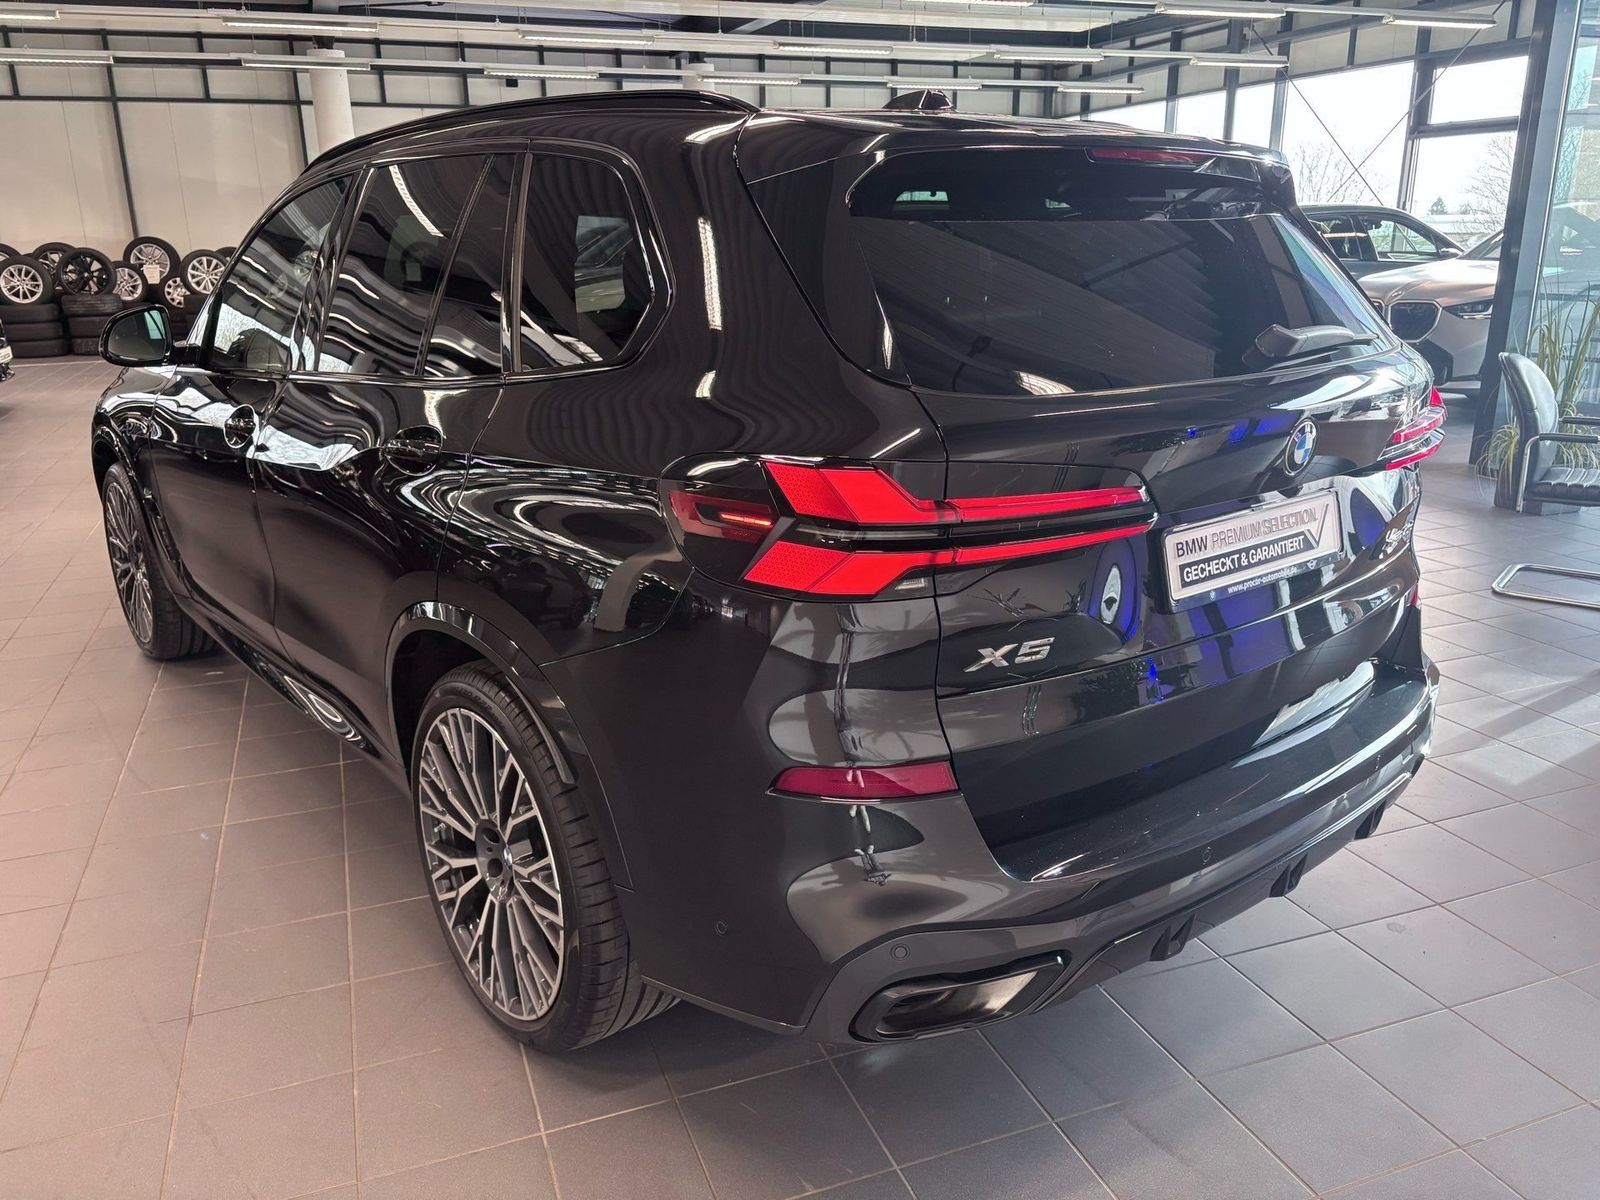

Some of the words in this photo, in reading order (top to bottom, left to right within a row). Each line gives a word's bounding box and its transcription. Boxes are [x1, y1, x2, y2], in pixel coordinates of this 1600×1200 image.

[1175, 535, 1208, 558] BMW
[1211, 520, 1263, 549] PREMIUM
[1183, 554, 1240, 583] GECHECKT
[1240, 552, 1249, 567] &
[1249, 535, 1305, 563] GARANTIERT
[963, 637, 1056, 673] X5
